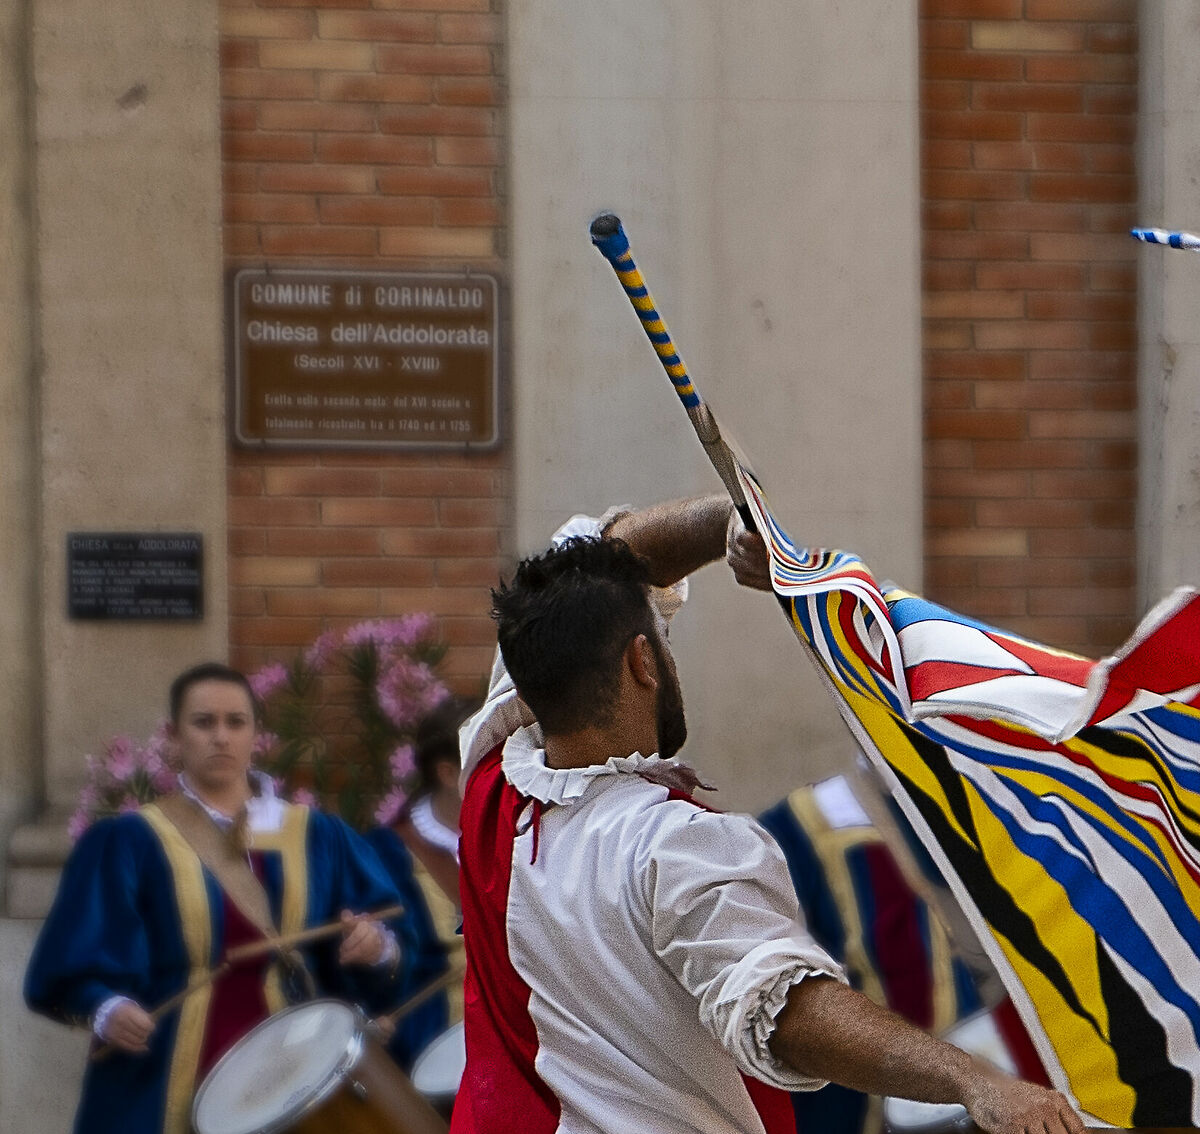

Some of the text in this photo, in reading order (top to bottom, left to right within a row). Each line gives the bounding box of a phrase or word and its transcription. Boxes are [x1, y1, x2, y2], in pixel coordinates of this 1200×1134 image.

[251, 284, 482, 308] COMUNE di CORINALDO
[247, 320, 489, 345] Chiesa dell'Addolorata
[294, 354, 344, 369] (Secoli
[353, 356, 379, 369] XVI
[401, 356, 440, 371] XVIII)
